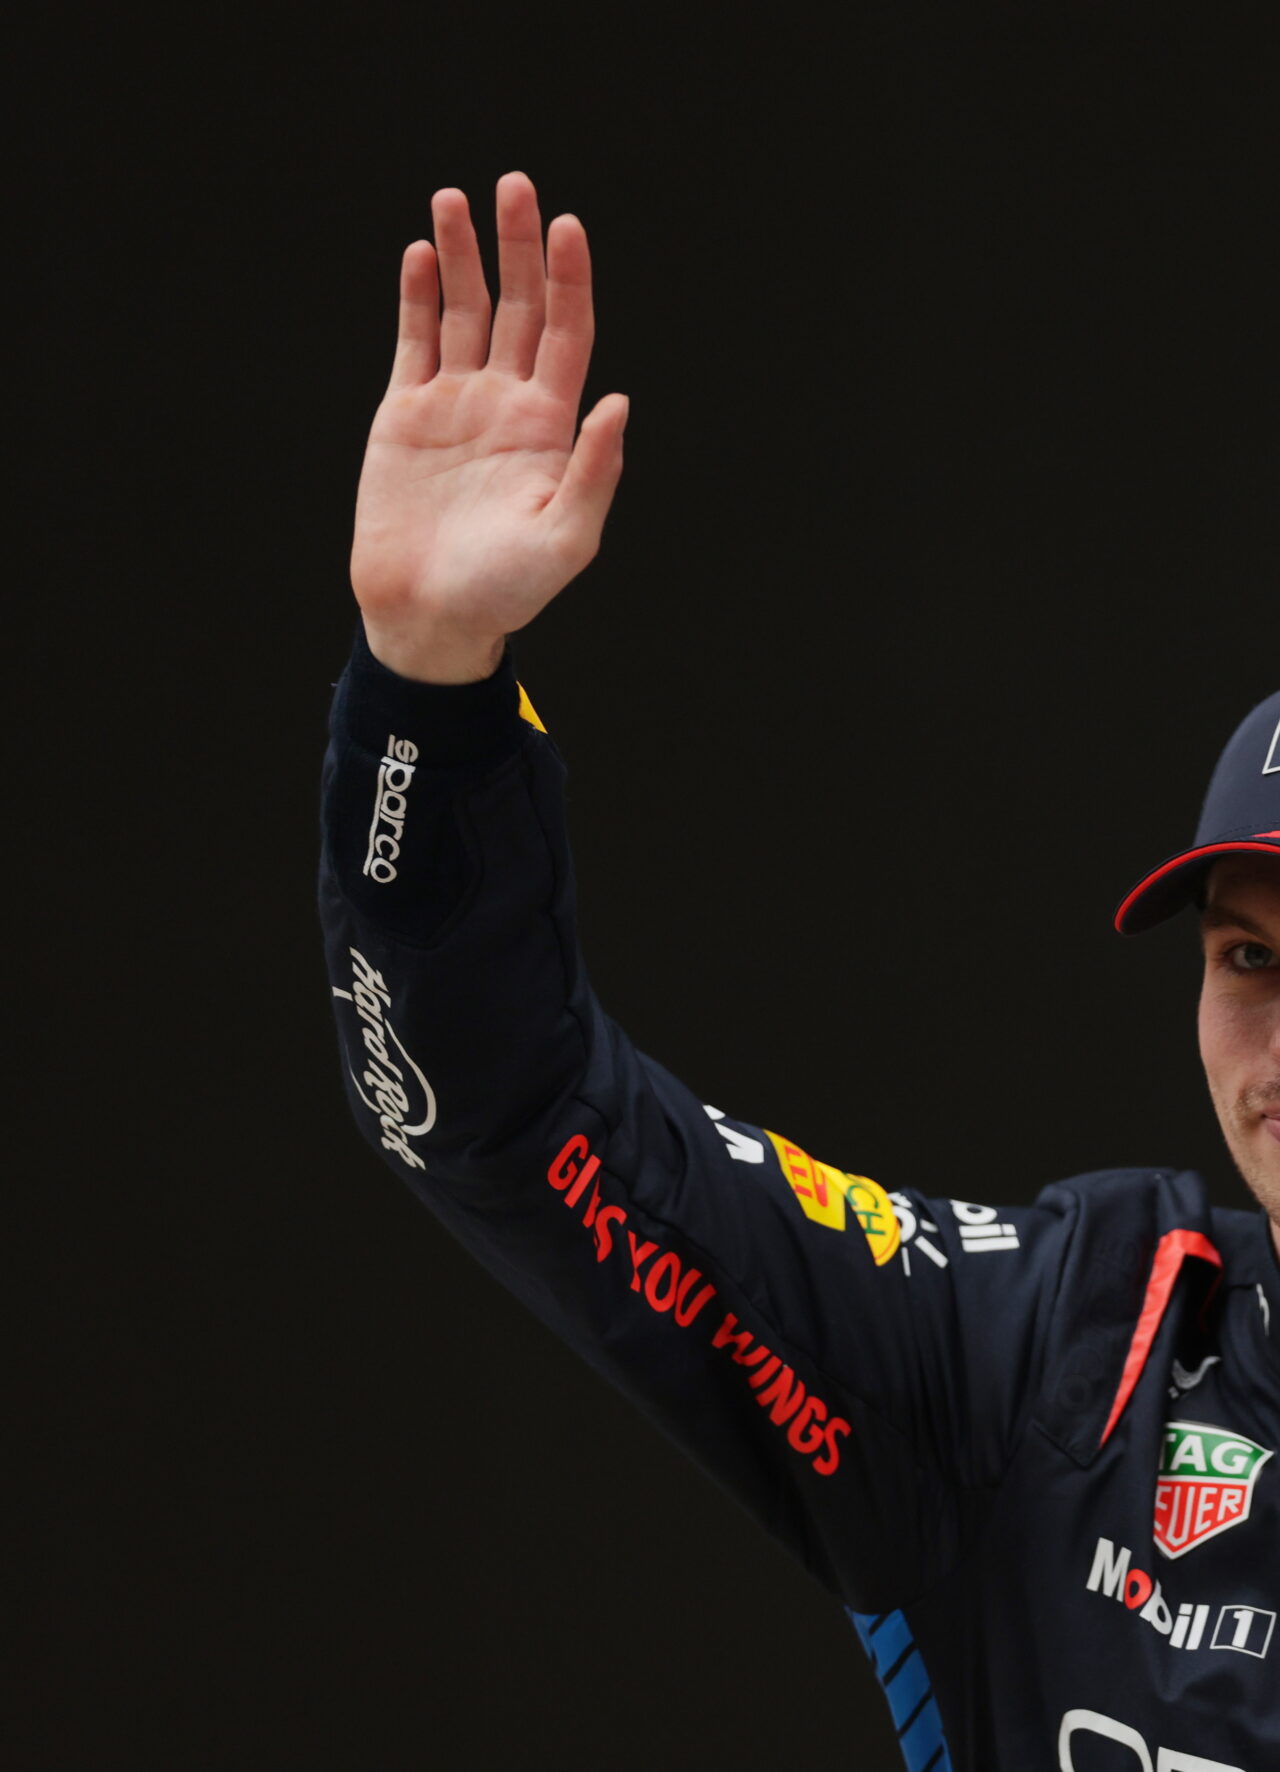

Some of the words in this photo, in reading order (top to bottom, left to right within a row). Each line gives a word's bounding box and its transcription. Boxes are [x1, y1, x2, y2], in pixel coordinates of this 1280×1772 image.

[363, 735, 419, 884] sparco
[627, 1230, 717, 1327] YOU
[711, 1312, 851, 1476] WINGS
[1086, 1537, 1209, 1650] Mobil
